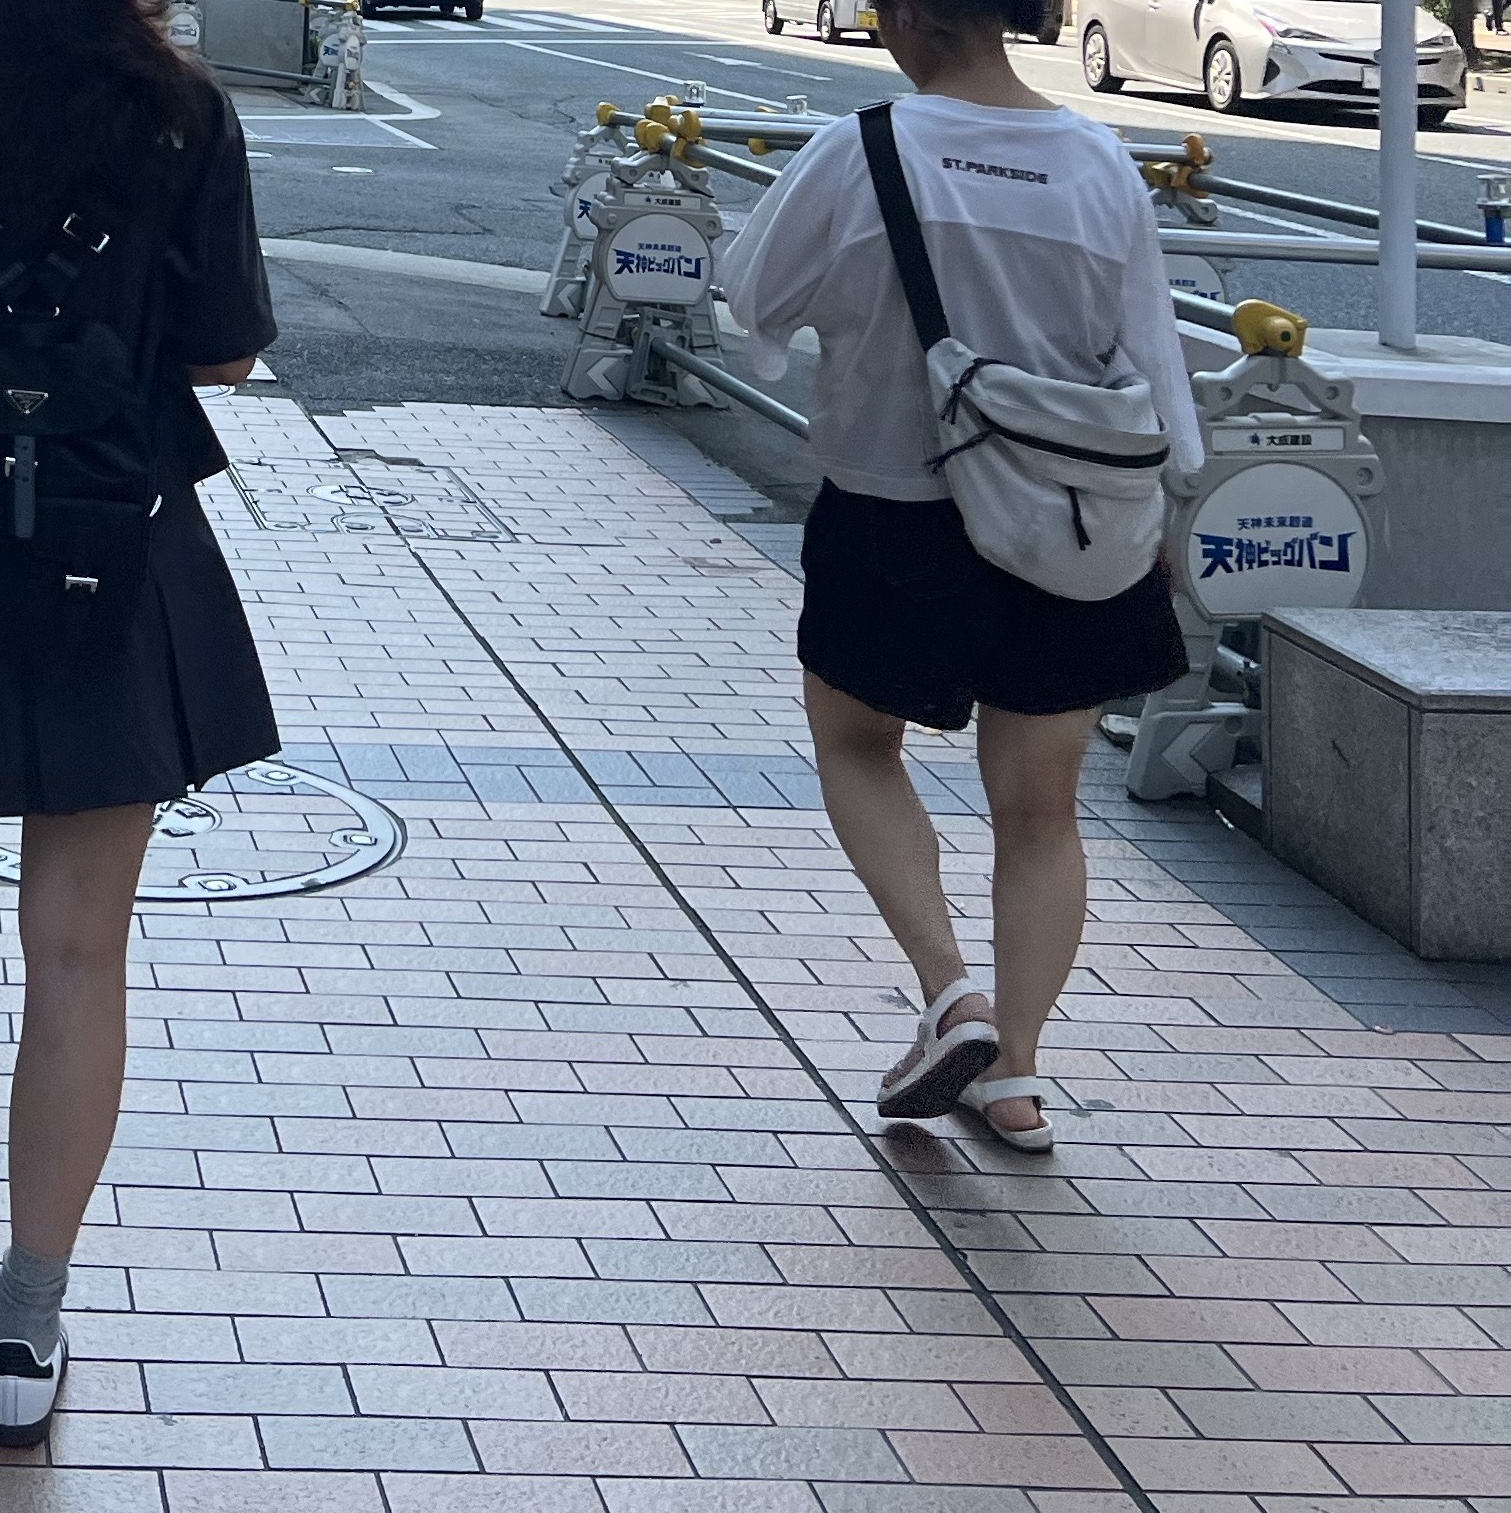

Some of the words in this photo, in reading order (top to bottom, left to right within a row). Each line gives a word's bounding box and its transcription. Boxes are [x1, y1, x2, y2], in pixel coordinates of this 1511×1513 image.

[942, 157, 1049, 185] ST.PARKSIDE
[611, 247, 706, 280] 天神ビッグバン
[1266, 434, 1312, 446] 大成建設
[1192, 531, 1358, 580] 天神ビッグバン
